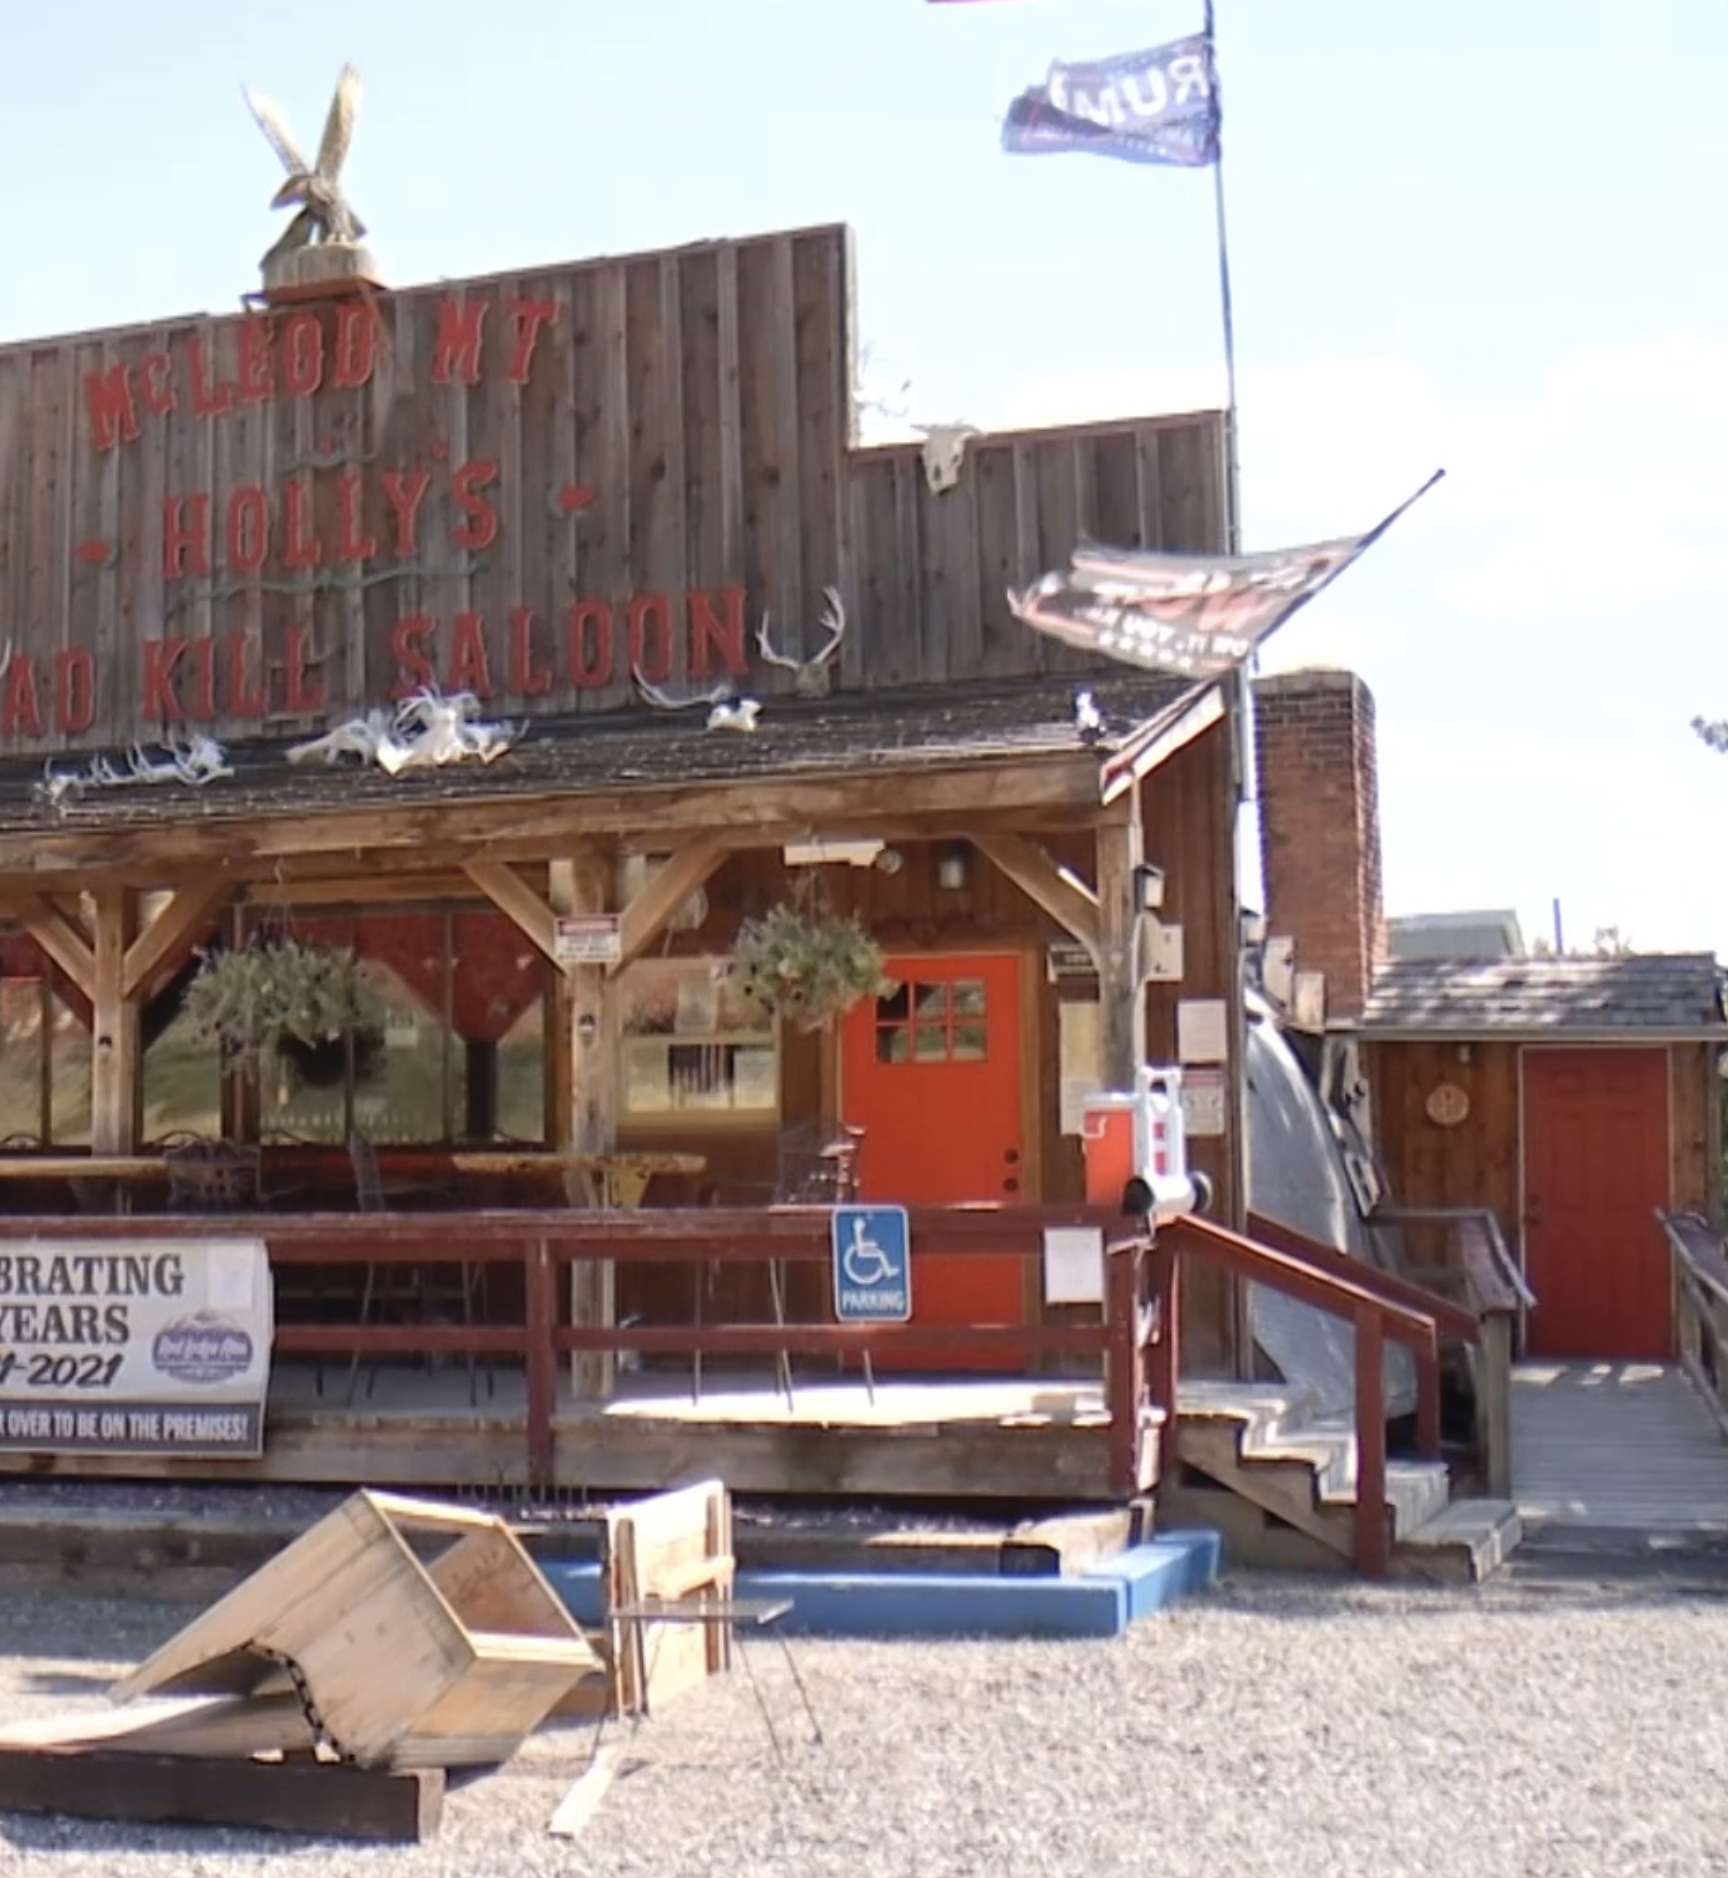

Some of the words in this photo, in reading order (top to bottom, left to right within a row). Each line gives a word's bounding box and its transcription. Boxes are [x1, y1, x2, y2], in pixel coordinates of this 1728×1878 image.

[139, 622, 330, 722] KILL
[388, 582, 752, 702] SALOON
[842, 1290, 905, 1311] PARKING
[8, 1408, 53, 1438] OVER
[53, 1409, 74, 1438] TO
[76, 1411, 99, 1439] BE
[101, 1411, 126, 1440] ON
[128, 1412, 161, 1441] THE
[162, 1413, 250, 1442] PREMISES!
